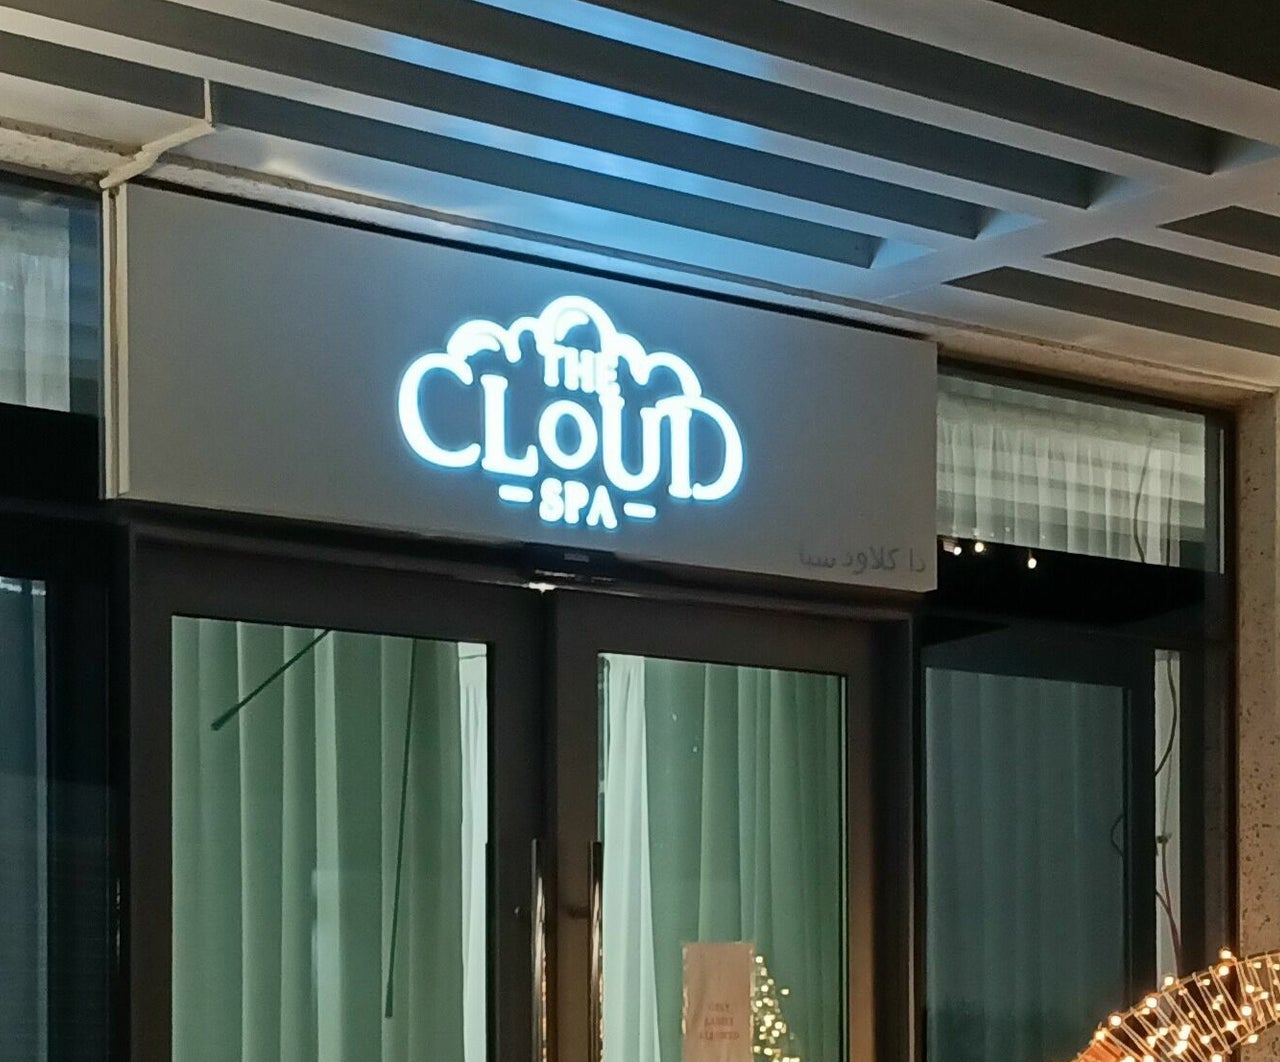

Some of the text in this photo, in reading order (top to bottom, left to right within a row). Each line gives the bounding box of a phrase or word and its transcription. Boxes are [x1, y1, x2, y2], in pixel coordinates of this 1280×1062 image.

[540, 343, 622, 396] THE
[398, 351, 744, 501] CLOUD
[538, 476, 618, 530] SPA
